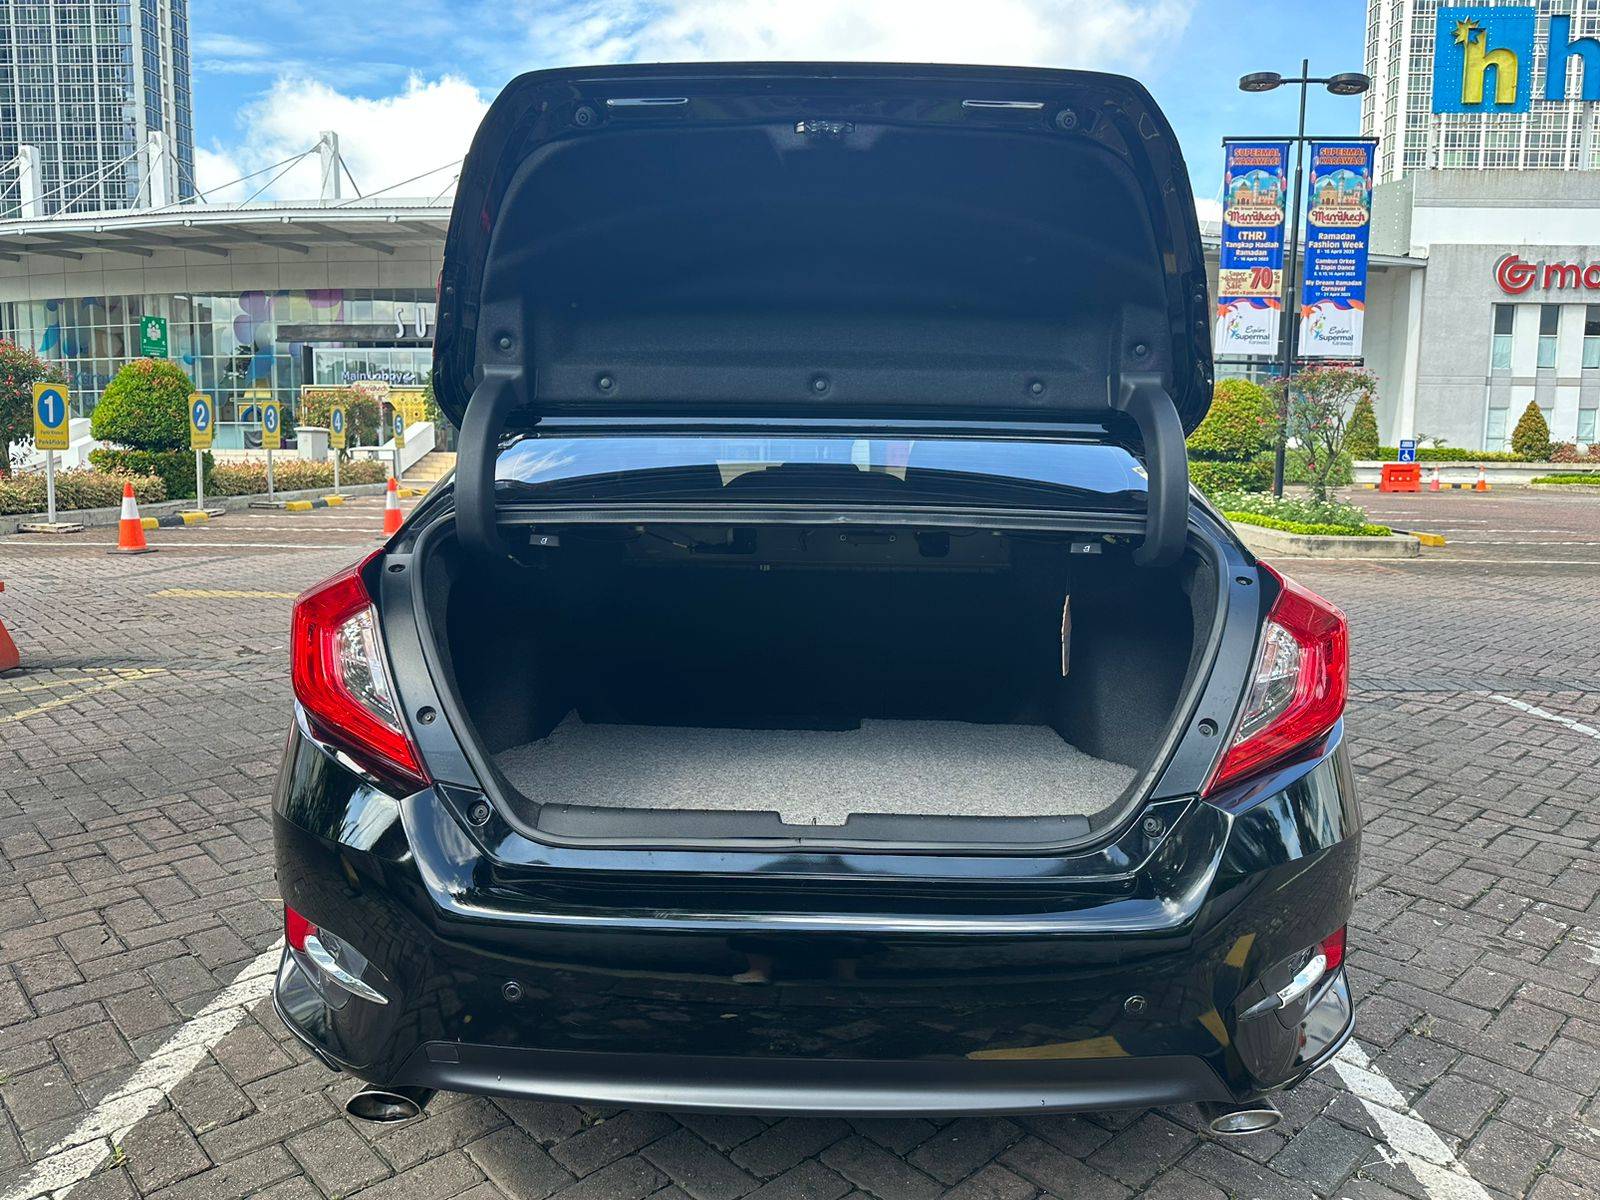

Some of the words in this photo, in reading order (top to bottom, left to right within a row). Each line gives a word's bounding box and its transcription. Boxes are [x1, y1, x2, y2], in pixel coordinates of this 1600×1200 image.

[1234, 148, 1280, 157] SUPERMAL
[1320, 147, 1366, 156] SUPERMAL
[1238, 231, 1267, 240] (THR)
[1318, 232, 1356, 240] Ramadan
[1250, 266, 1273, 289] 70
[1234, 333, 1270, 341] Supermal
[1318, 334, 1354, 342] Supermal
[341, 370, 367, 381] Main
[44, 395, 54, 423] 1
[196, 404, 206, 427] 2
[267, 408, 275, 429] 3
[334, 411, 341, 430] 4
[394, 416, 402, 434] 5
